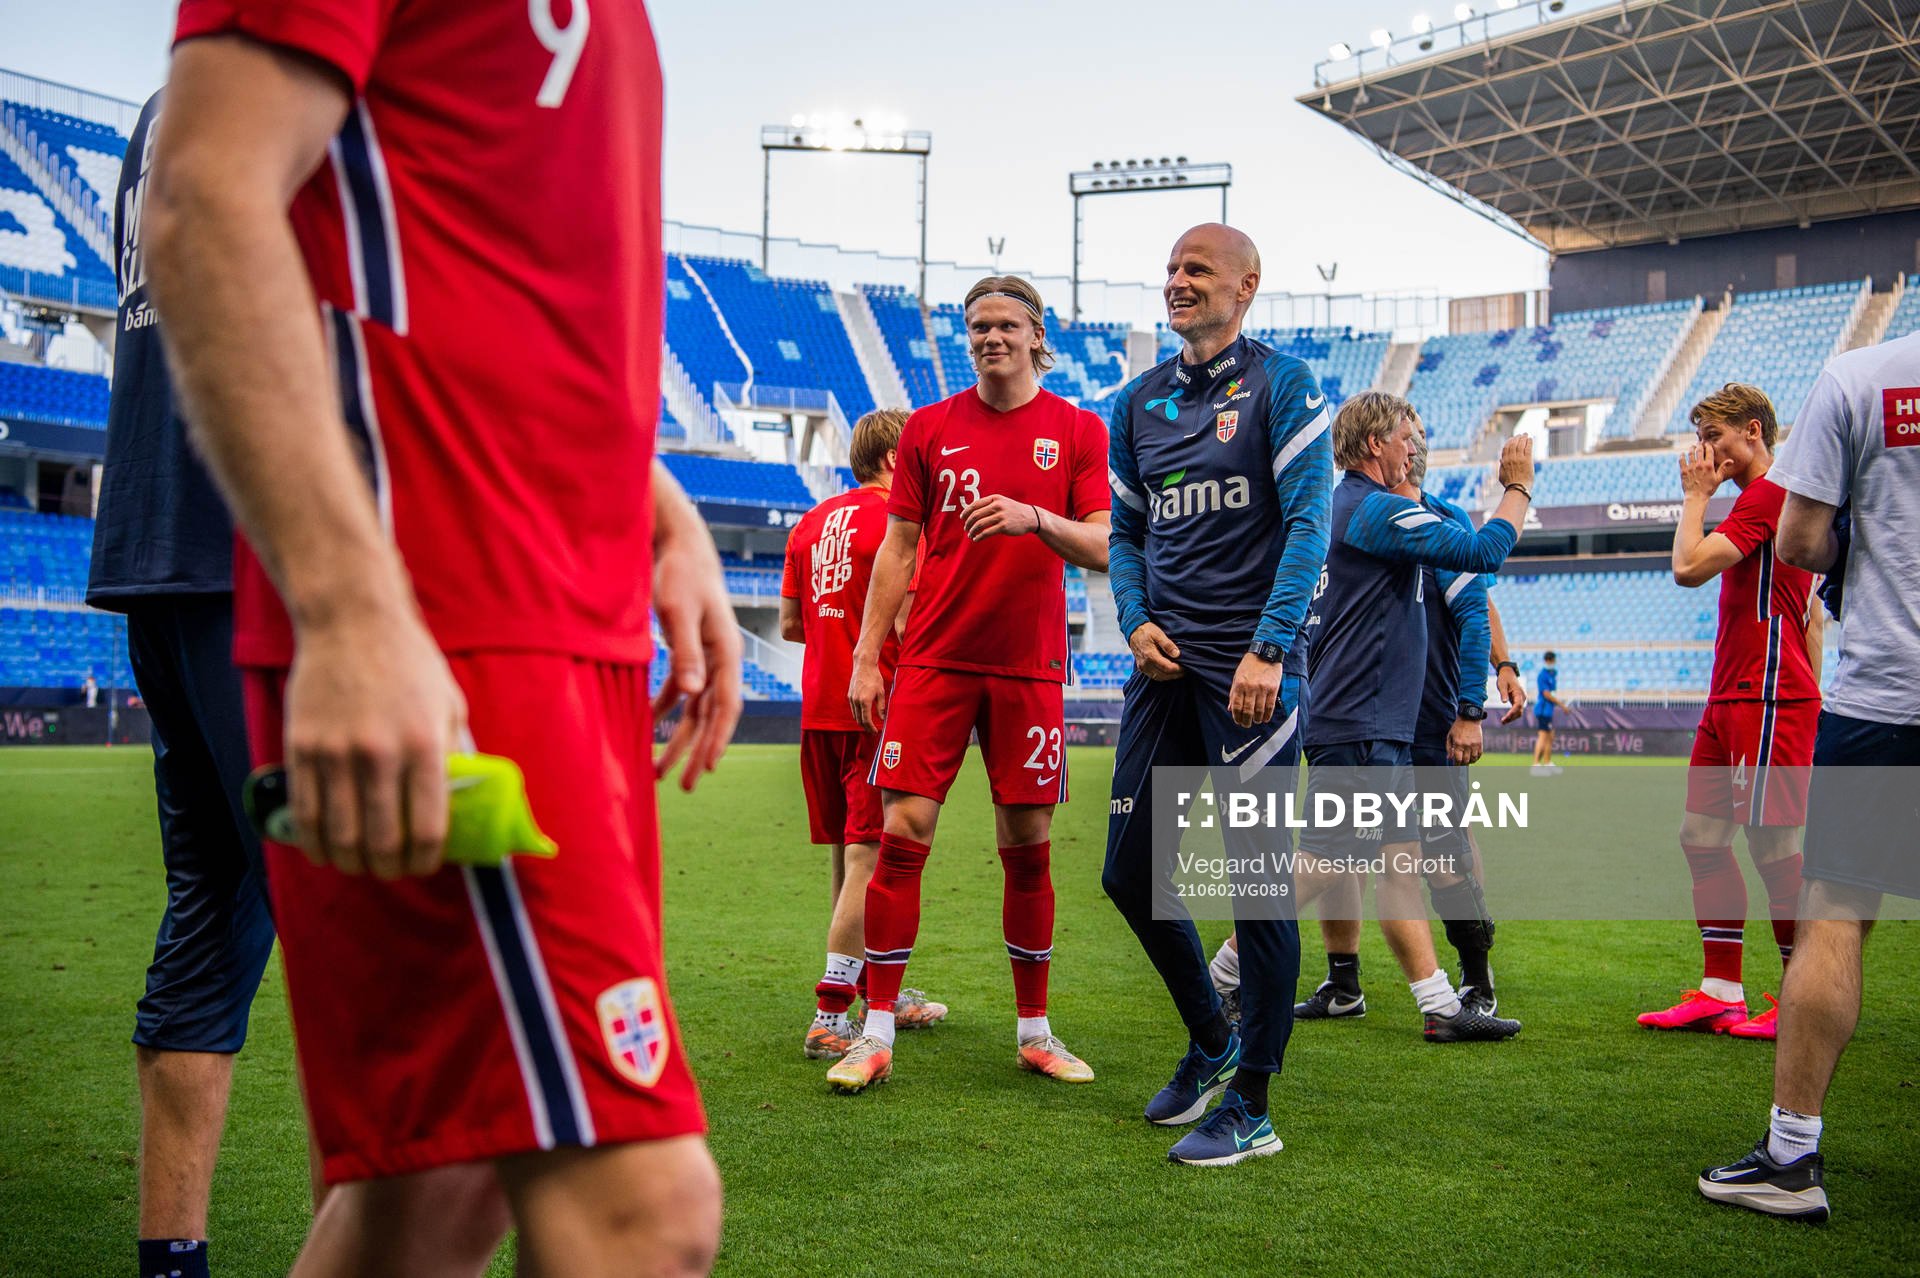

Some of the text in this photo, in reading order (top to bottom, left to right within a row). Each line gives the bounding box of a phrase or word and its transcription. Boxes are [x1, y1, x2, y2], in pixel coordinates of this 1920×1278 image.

[527, 0, 591, 109] 9
[939, 468, 980, 512] 23
[821, 505, 860, 540] EAT
[811, 528, 858, 574] MOVE
[1023, 726, 1061, 771] 23
